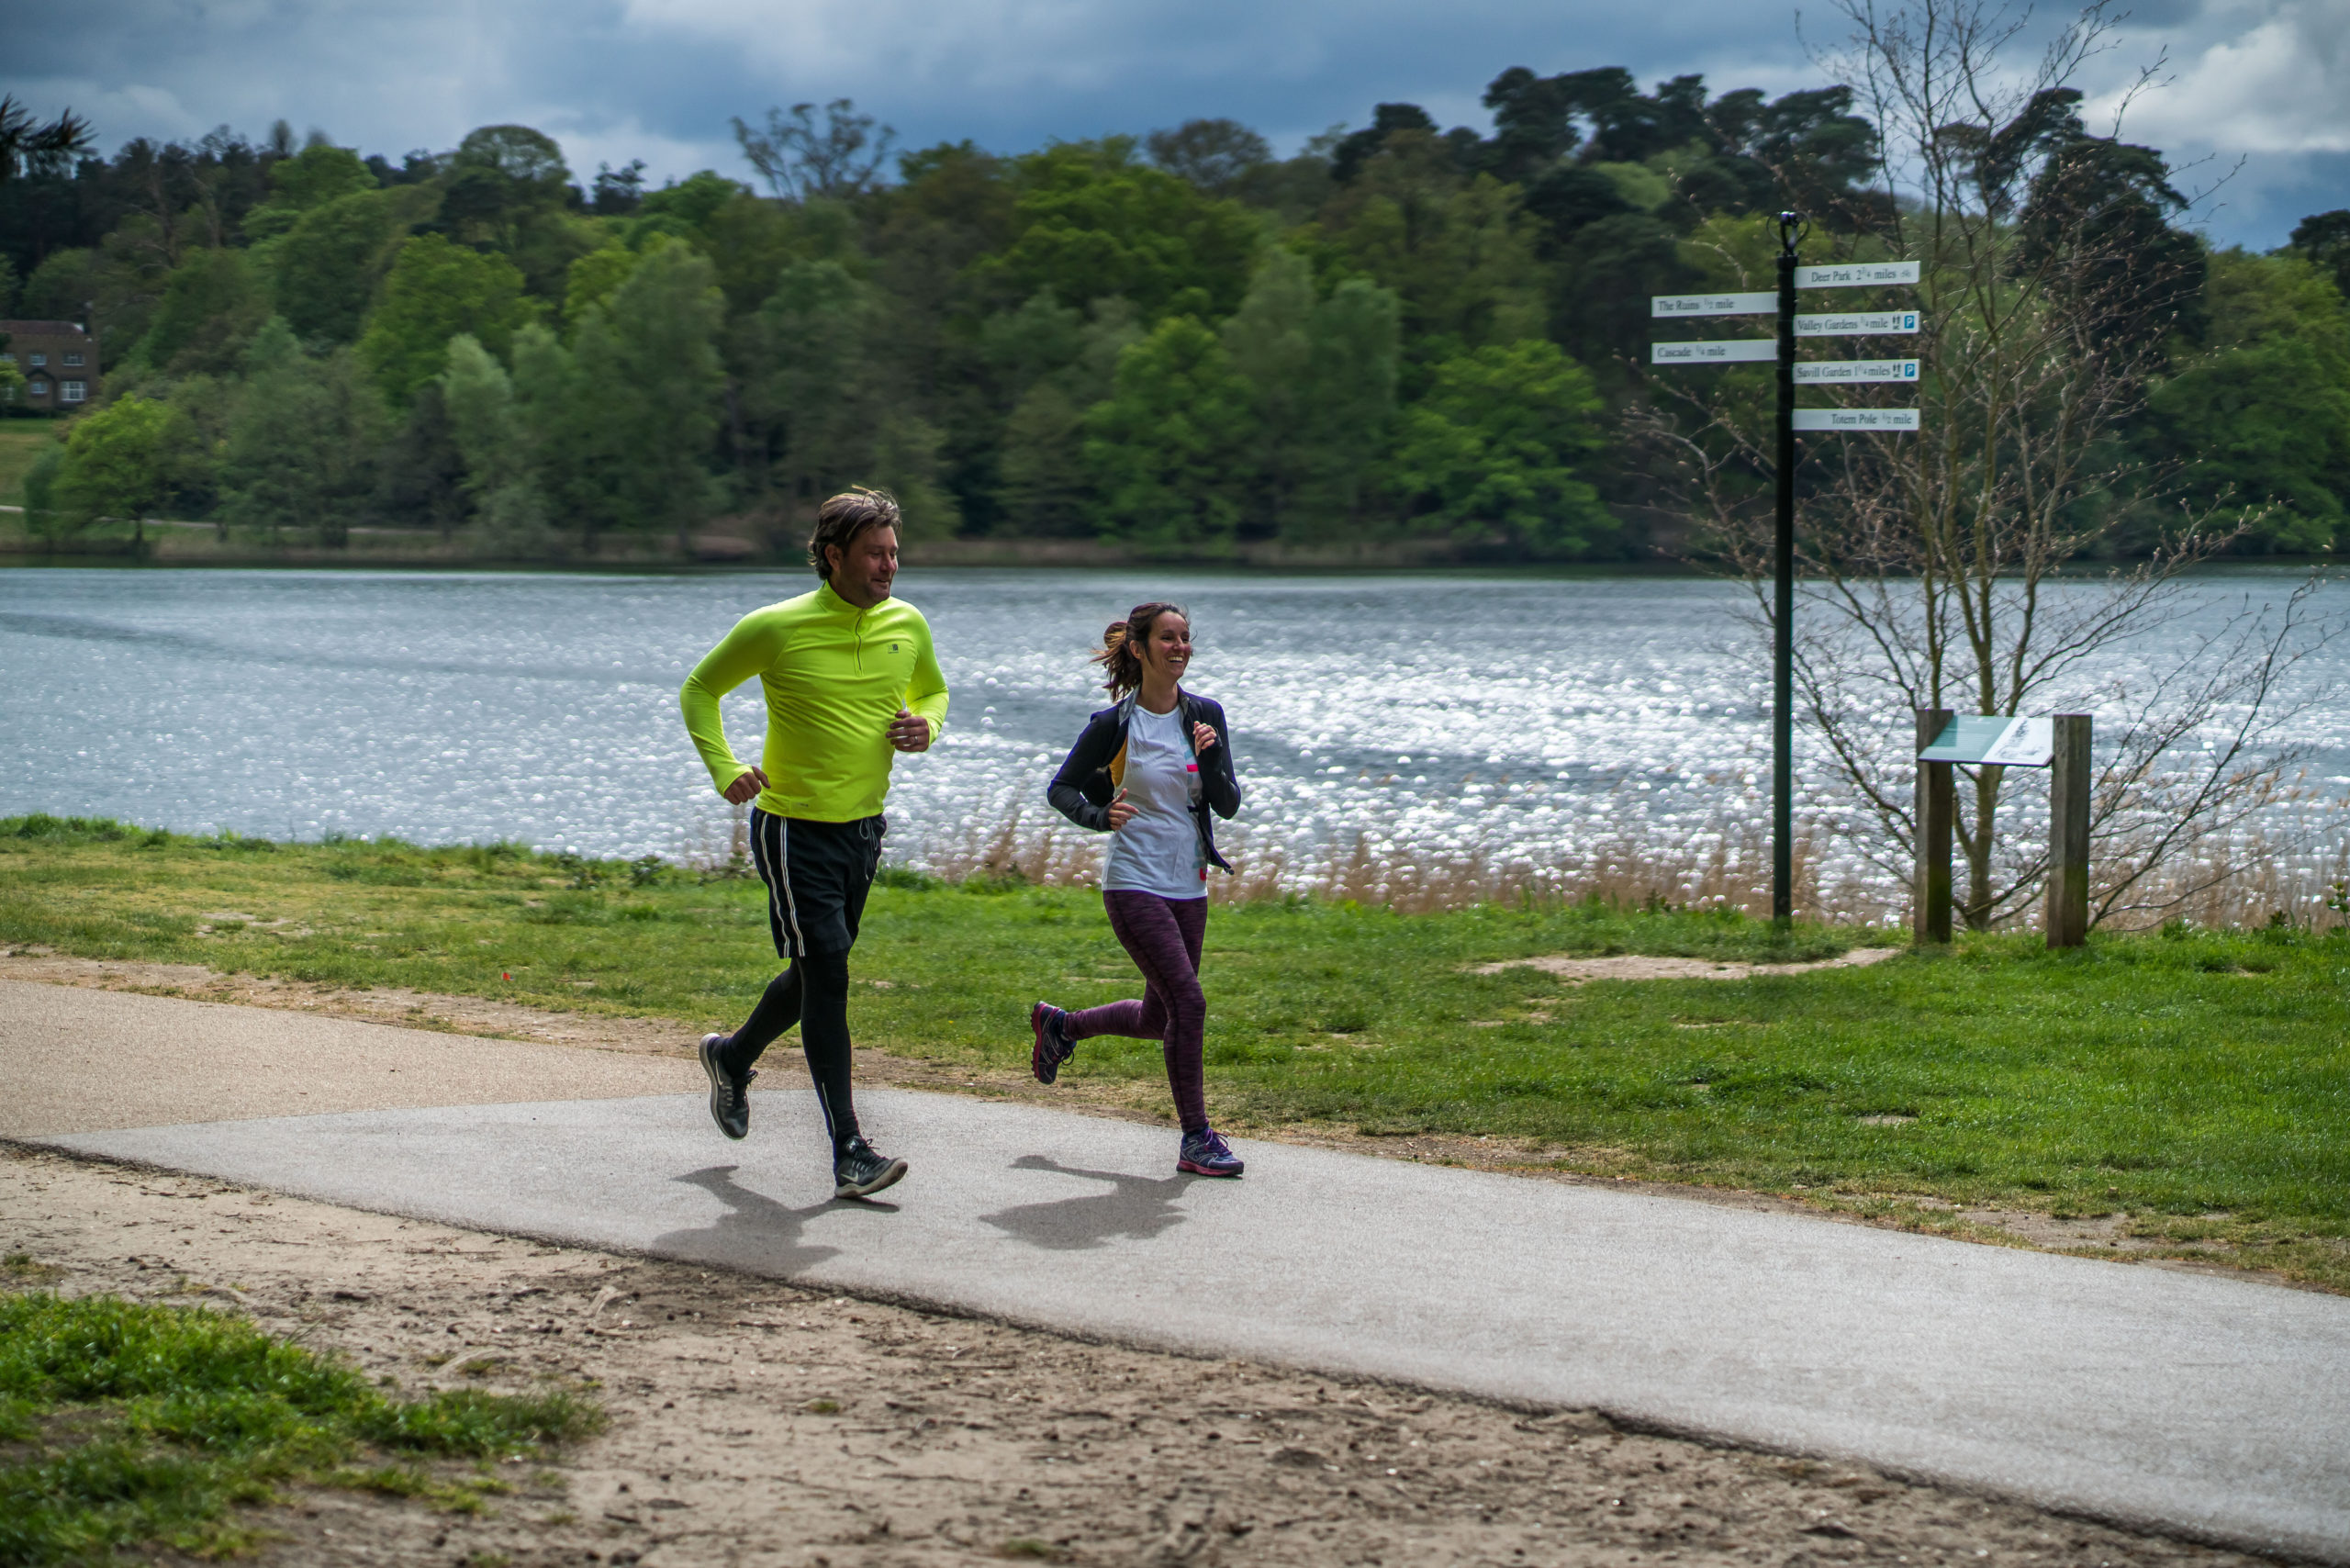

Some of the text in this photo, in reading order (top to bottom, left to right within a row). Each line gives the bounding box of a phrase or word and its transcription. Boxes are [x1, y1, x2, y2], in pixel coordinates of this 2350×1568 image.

[1811, 272, 1830, 282] Deer
[1833, 271, 1851, 281] Park
[1874, 269, 1896, 279] miles
[1658, 300, 1673, 310] The
[1716, 298, 1734, 308] mile
[1797, 319, 1822, 332] Valley
[1825, 319, 1858, 330] Gardens
[1870, 318, 1887, 328] mile
[1658, 347, 1691, 357] Cascade
[1707, 346, 1726, 356] mile
[1797, 367, 1819, 377] Savill
[1822, 367, 1852, 377] Garden
[1868, 365, 1890, 375] miles
[1831, 414, 1856, 424] Totem
[1859, 414, 1877, 423] Pole
[1894, 413, 1912, 423] mile
